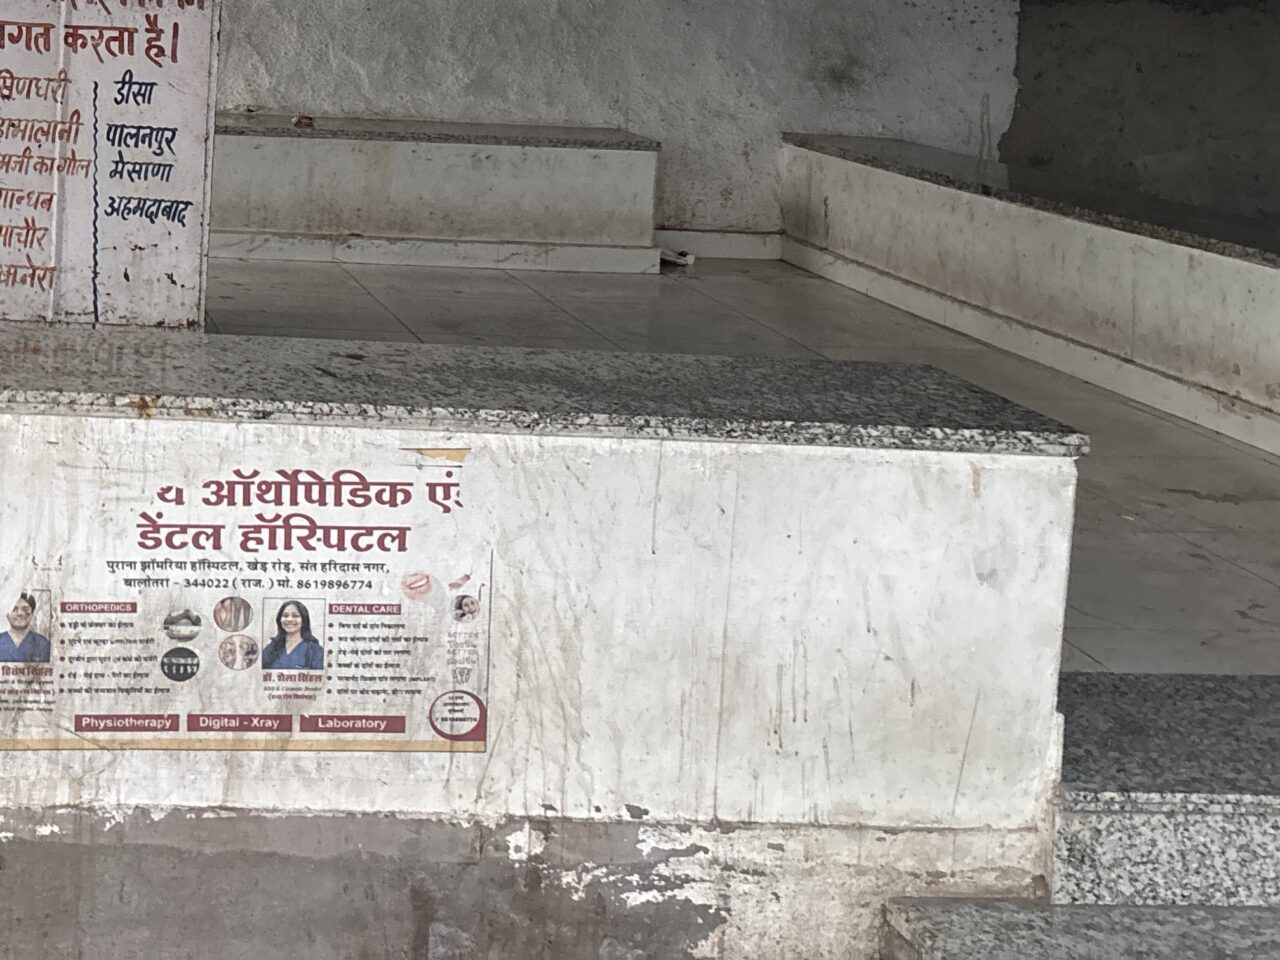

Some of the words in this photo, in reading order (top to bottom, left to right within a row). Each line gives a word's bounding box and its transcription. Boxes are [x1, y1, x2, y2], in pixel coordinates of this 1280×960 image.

[64, 25, 138, 63] करता
[113, 69, 157, 106] डीसा
[107, 123, 177, 155] पालनपुर
[34, 155, 56, 175] का
[57, 149, 90, 177] गोल
[109, 151, 174, 182] मेसाणा
[104, 196, 193, 227] अहमदाबाद
[202, 469, 413, 508] ऑर्थोपेडिक
[426, 471, 463, 513] एं
[137, 512, 225, 550] डेंटल
[238, 513, 411, 552] हॉस्पिटल
[107, 560, 136, 573] पुराना
[299, 560, 317, 572] संत
[321, 560, 359, 573] हरिदास
[363, 564, 389, 574] नगर,
[124, 576, 169, 588] बालोतरा
[184, 579, 229, 588] 344022
[297, 580, 373, 589] 8619896774
[332, 605, 370, 613] DENTAL
[81, 717, 172, 732] Physiotherapy
[200, 717, 240, 728] Digital
[251, 718, 279, 729] Xray
[318, 718, 387, 730] Laboratory
